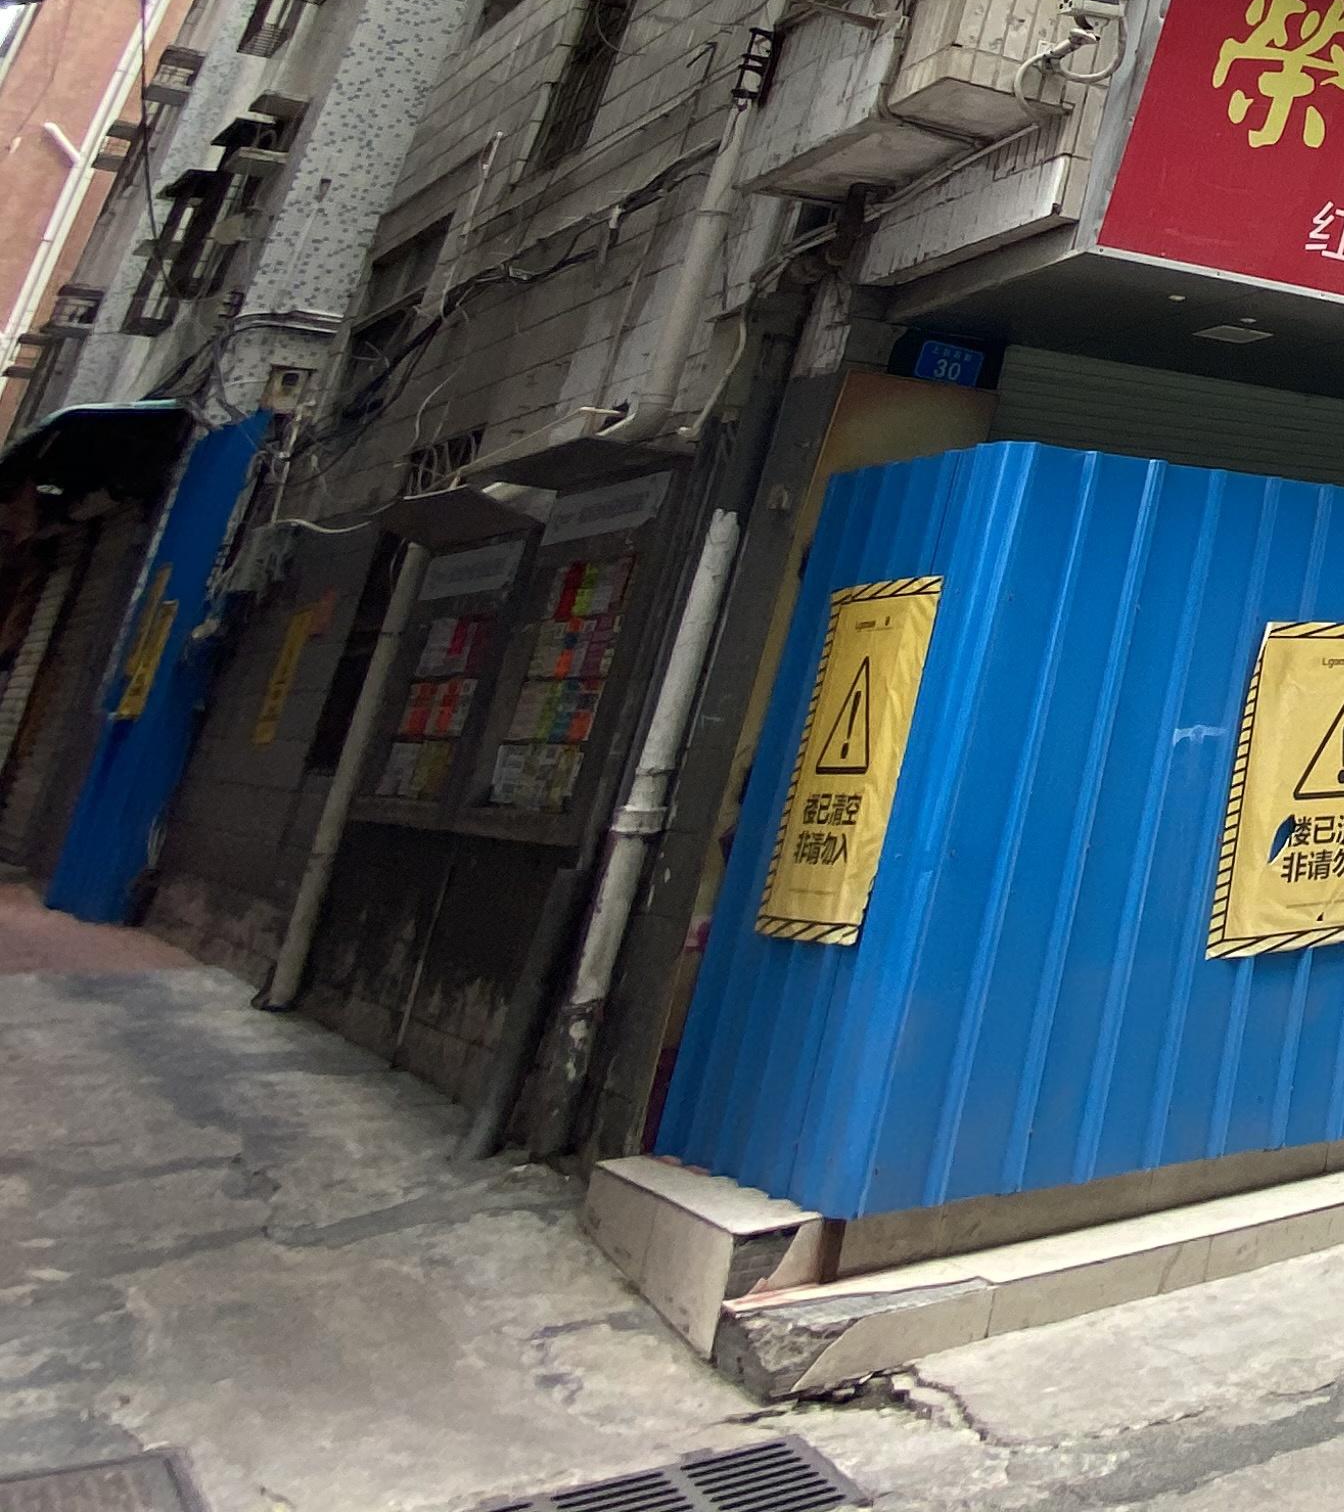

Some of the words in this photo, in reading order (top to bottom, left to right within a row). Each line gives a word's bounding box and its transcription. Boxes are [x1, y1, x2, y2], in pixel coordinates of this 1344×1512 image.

[933, 358, 962, 381] 30
[803, 792, 863, 827] 楼已清空
[793, 832, 848, 866] 非请勿入
